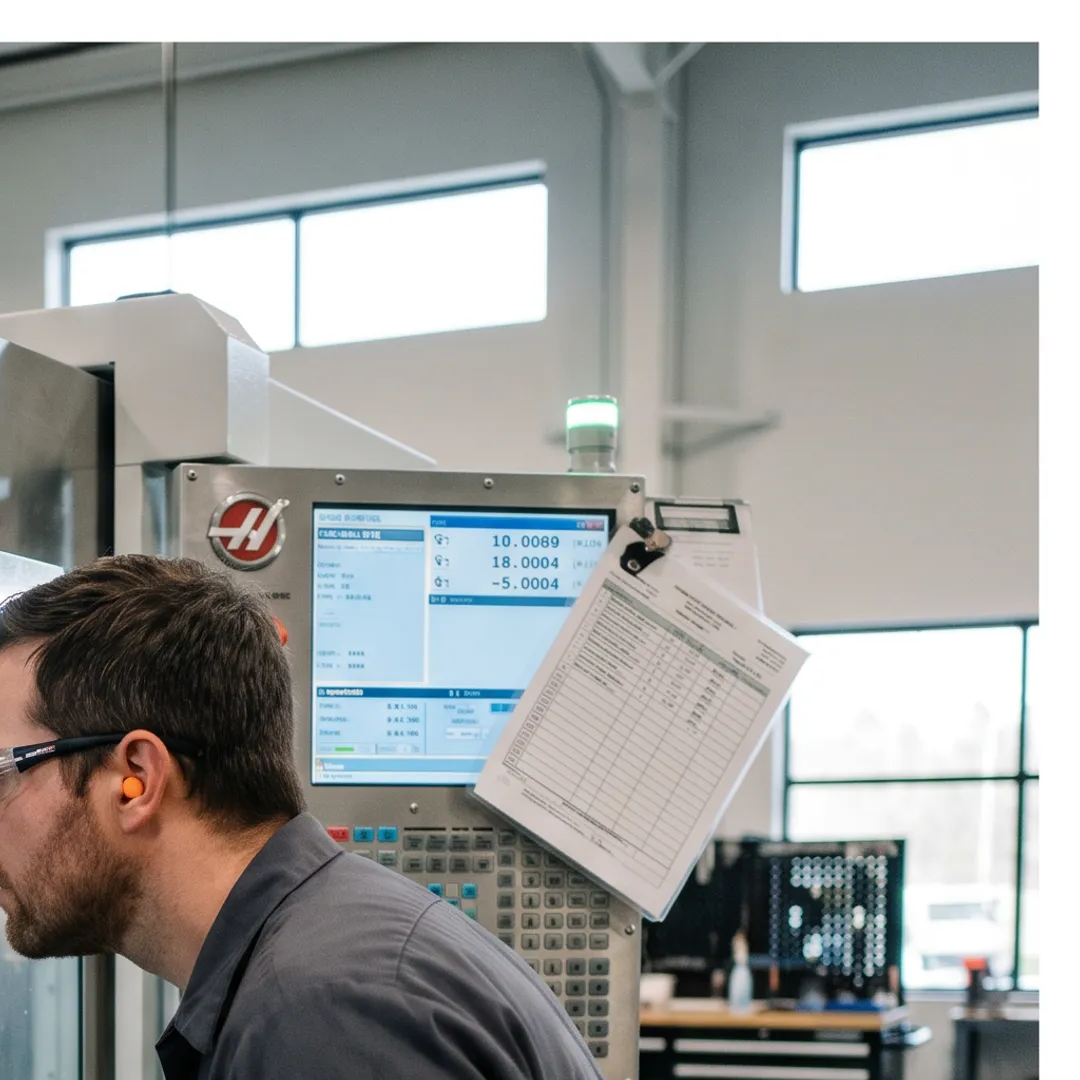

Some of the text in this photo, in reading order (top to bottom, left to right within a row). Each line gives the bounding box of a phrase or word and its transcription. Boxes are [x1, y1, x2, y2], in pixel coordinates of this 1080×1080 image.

[492, 535, 560, 548] 10.0089
[492, 556, 559, 569] 18.0004
[492, 577, 559, 590] -5.0004
